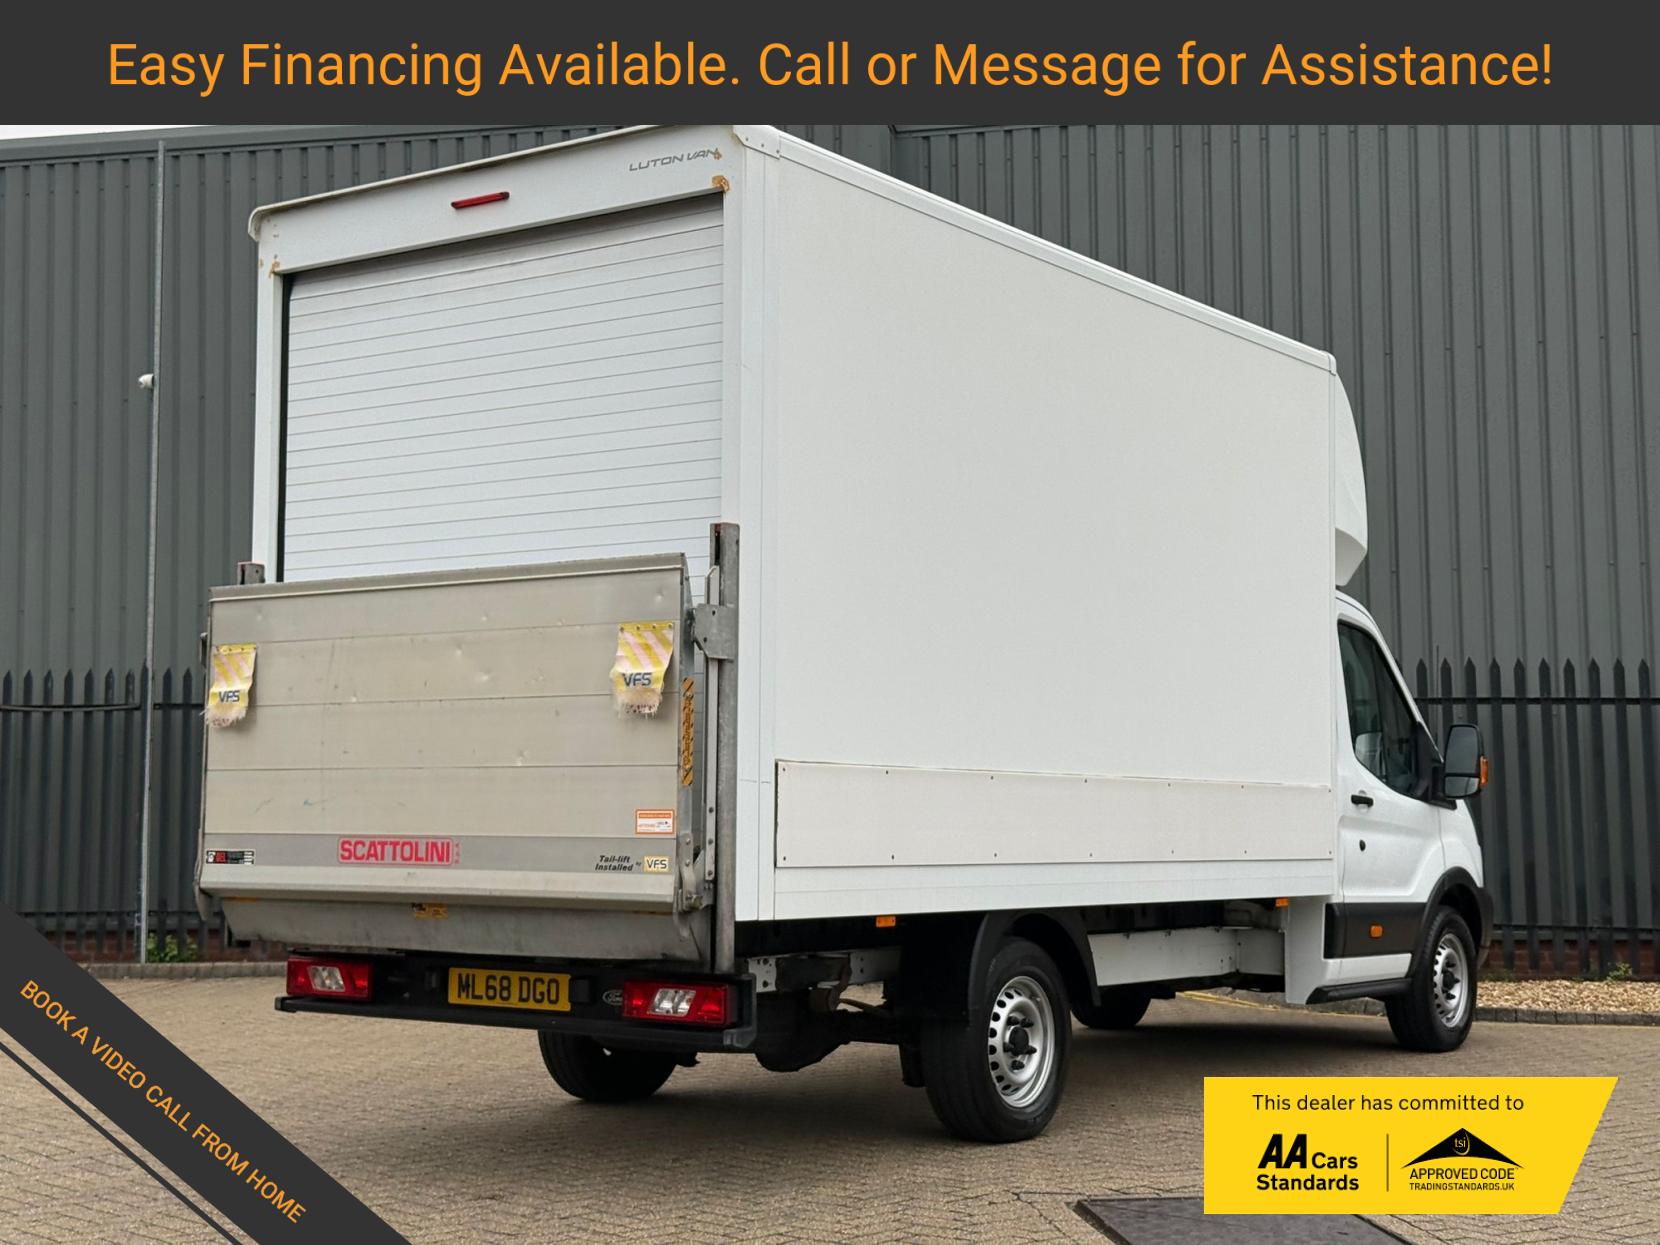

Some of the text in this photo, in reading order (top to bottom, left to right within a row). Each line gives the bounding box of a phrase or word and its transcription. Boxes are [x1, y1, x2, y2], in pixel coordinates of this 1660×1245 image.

[629, 148, 720, 171] LUTON VAN
[623, 672, 652, 687] VFS
[219, 689, 240, 703] VFS
[340, 839, 450, 863] SCATTOLINI
[599, 855, 630, 864] Tail-lift
[646, 858, 668, 869] VFS
[595, 863, 633, 872] Installed
[457, 973, 560, 1005] ML68 DGO
